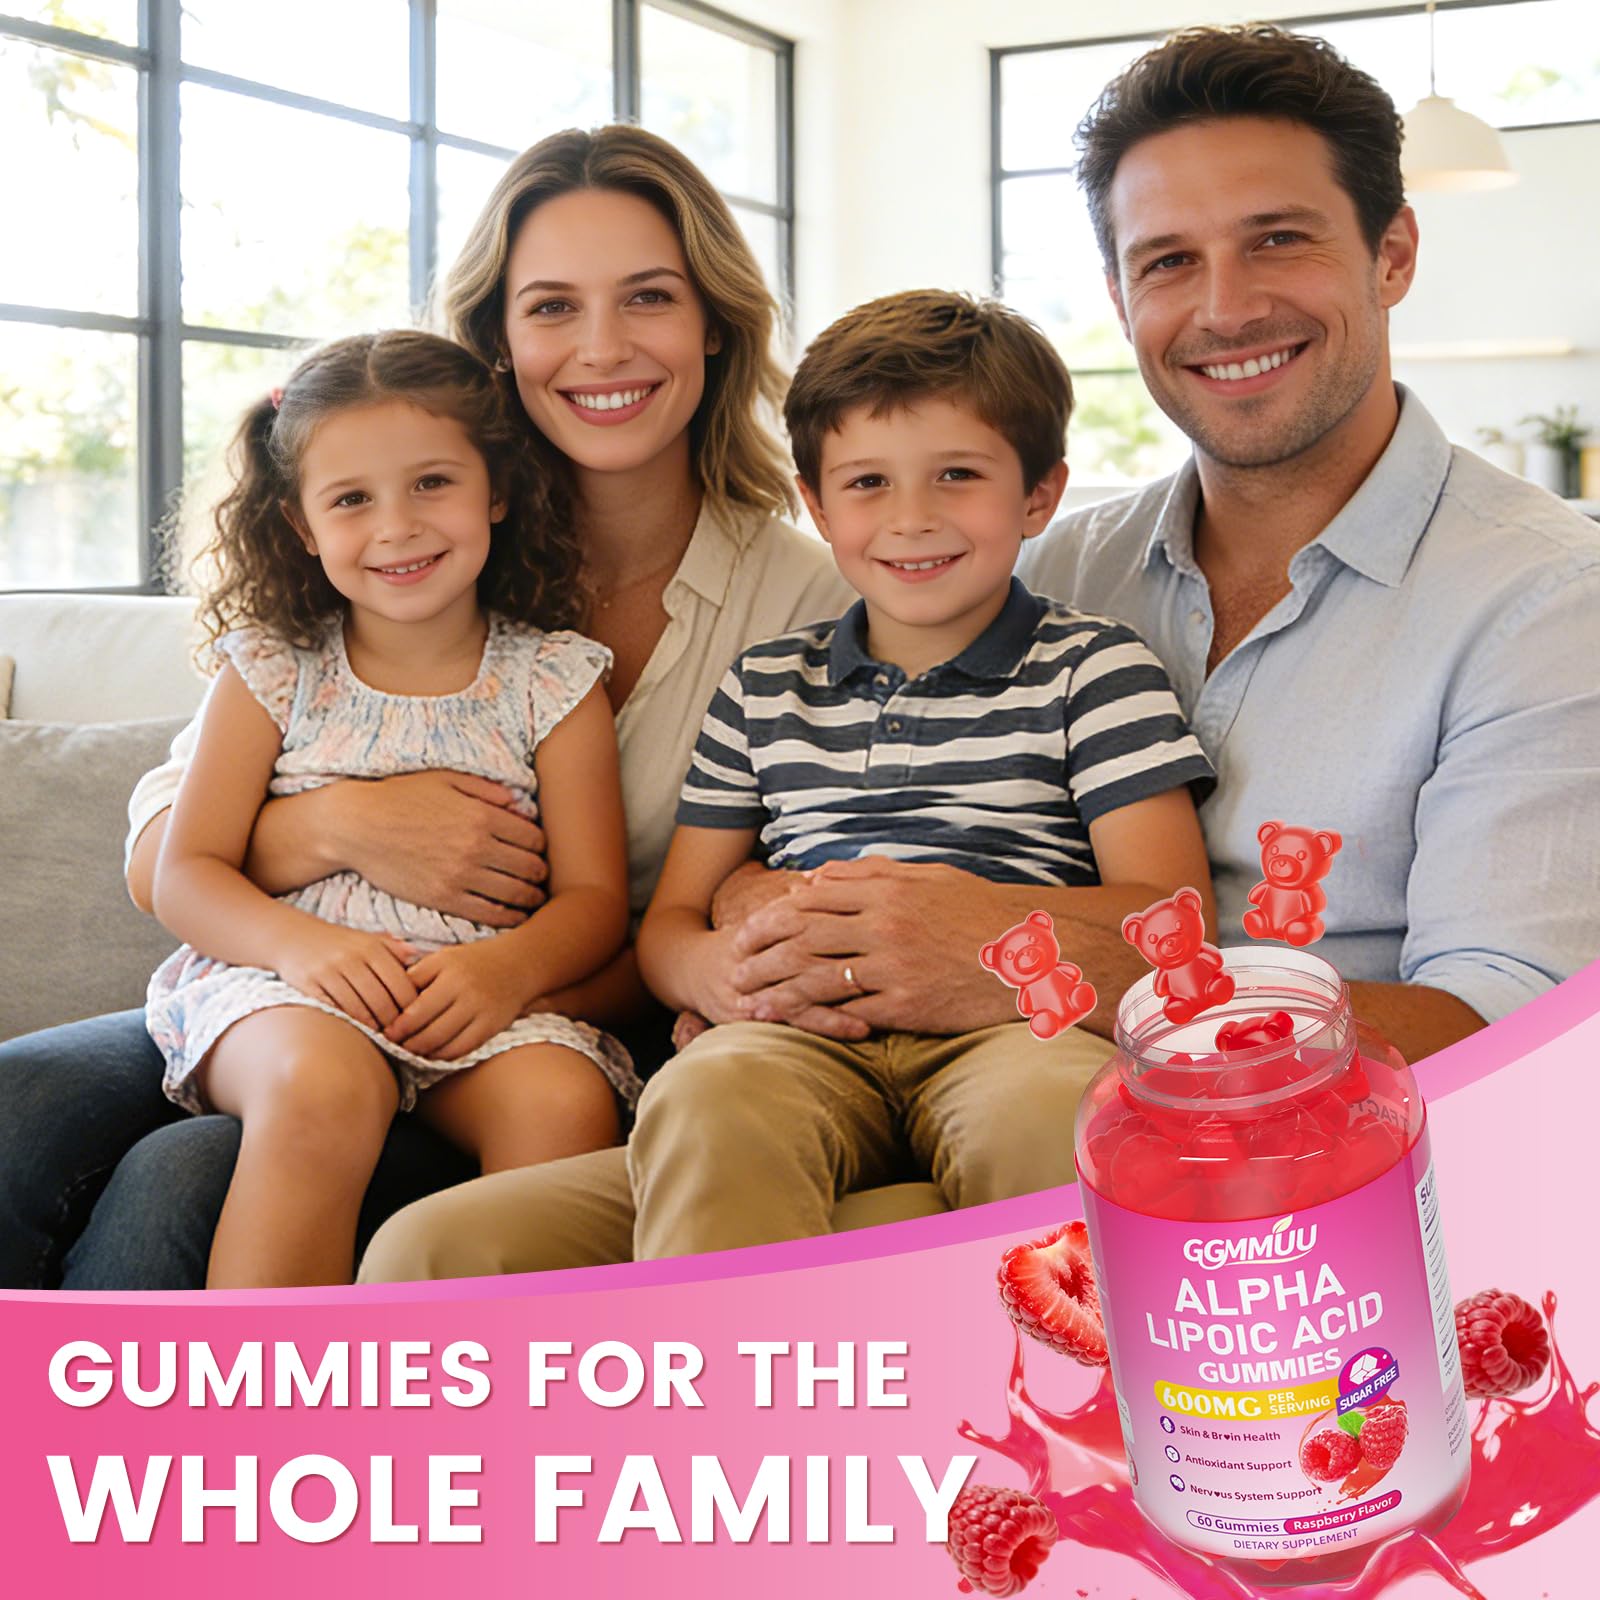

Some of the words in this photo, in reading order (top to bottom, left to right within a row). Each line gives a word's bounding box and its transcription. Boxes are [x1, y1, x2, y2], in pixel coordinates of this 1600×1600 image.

[1183, 1224, 1317, 1270] GGMMUU
[1175, 1263, 1346, 1316] ALPHA
[1146, 1312, 1278, 1355] LIPOIC
[1292, 1292, 1383, 1350] ACID
[1198, 1348, 1342, 1384] GUMMIES
[1268, 1391, 1295, 1405] PER
[1340, 1385, 1373, 1411] SUGAR
[1374, 1366, 1397, 1391] FREE
[1163, 1387, 1262, 1417] 600MG
[1269, 1396, 1331, 1416] SERVING
[1180, 1425, 1201, 1438] Skin
[1203, 1430, 1210, 1439] &
[1243, 1431, 1281, 1442] Health
[1185, 1454, 1245, 1470] Antioxidant
[1247, 1461, 1292, 1472] Support
[1235, 1491, 1274, 1502] System
[1277, 1487, 1322, 1501] Support
[1197, 1515, 1212, 1527] 60
[1215, 1519, 1279, 1533] Gummies
[1294, 1509, 1356, 1530] Raspberry
[1358, 1496, 1393, 1517] Flavor
[1233, 1539, 1279, 1550] DIETARY
[1282, 1528, 1358, 1549] SUPPLEMENT
